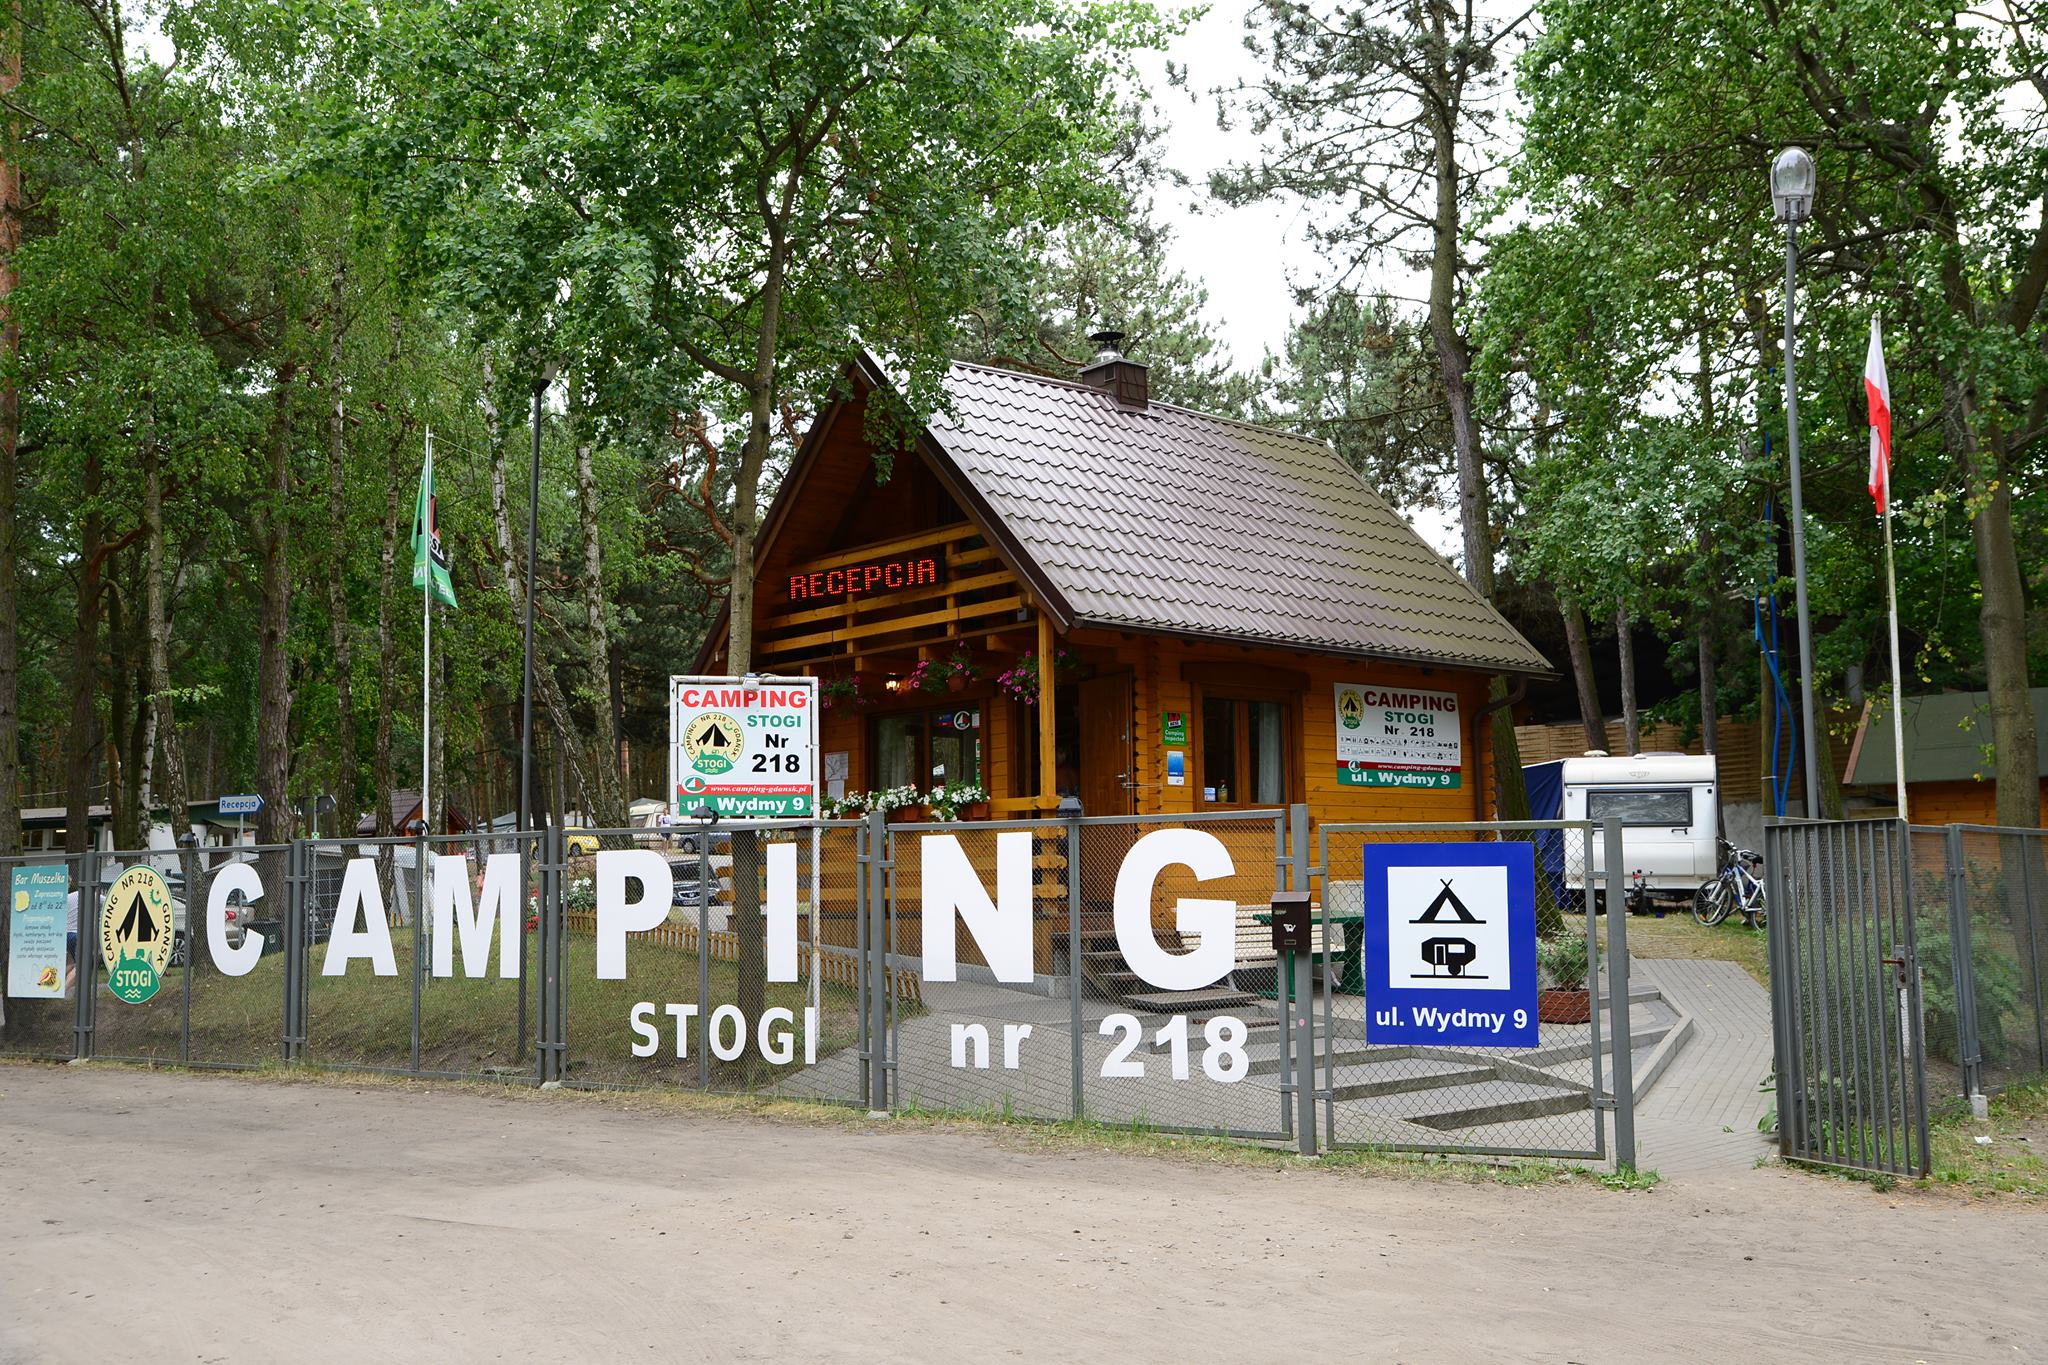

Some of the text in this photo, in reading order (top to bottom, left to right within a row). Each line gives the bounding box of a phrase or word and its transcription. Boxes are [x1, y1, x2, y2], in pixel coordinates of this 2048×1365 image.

[790, 559, 935, 600] RECEPCJA
[683, 689, 807, 709] CAMPING
[1364, 690, 1457, 713] CAMPING
[747, 714, 802, 728] STOGI
[1384, 711, 1434, 725] STOGI
[686, 723, 697, 755] CAMPING
[765, 733, 789, 748] Nr
[1410, 727, 1435, 737] 218
[697, 759, 727, 769] STOGI
[752, 753, 801, 773] 218
[1351, 771, 1451, 787] ul. Wydmy 9
[710, 784, 807, 794] www.camping-gdansk.pl
[221, 799, 256, 810] Recepcja
[717, 797, 787, 814] Wydmy
[792, 797, 805, 811] 9
[15, 873, 29, 886] Bar
[121, 872, 154, 890] NR 218
[206, 828, 1237, 990] CAMPING
[103, 894, 118, 962] CAMPING
[116, 969, 152, 988] STOGI
[1375, 1007, 1528, 1034] ul. Wydmy 9
[630, 1001, 816, 1065] STOGI
[950, 1013, 1250, 1084] nr 218
